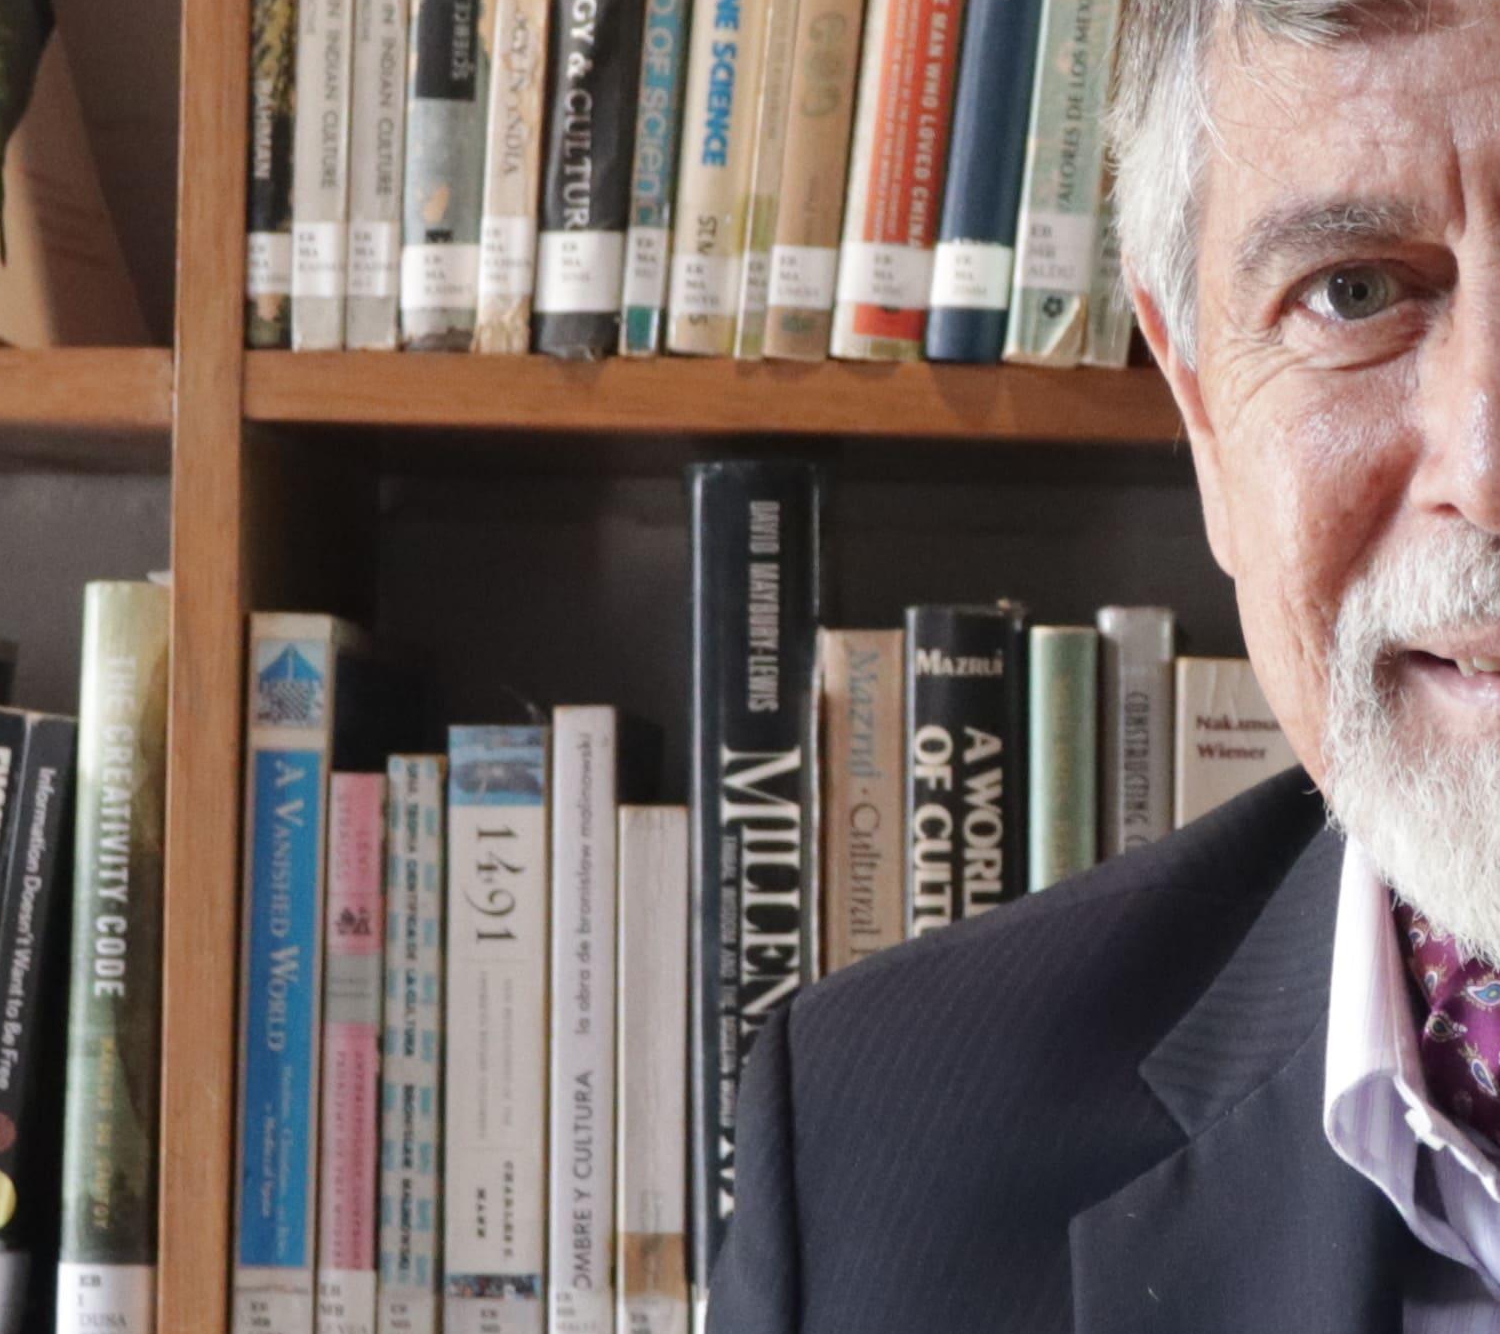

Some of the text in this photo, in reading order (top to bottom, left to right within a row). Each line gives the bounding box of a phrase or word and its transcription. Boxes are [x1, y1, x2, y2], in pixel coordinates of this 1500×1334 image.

[570, 53, 596, 77] &
[703, 40, 741, 167] SCIENCE
[463, 822, 525, 946] 1491
